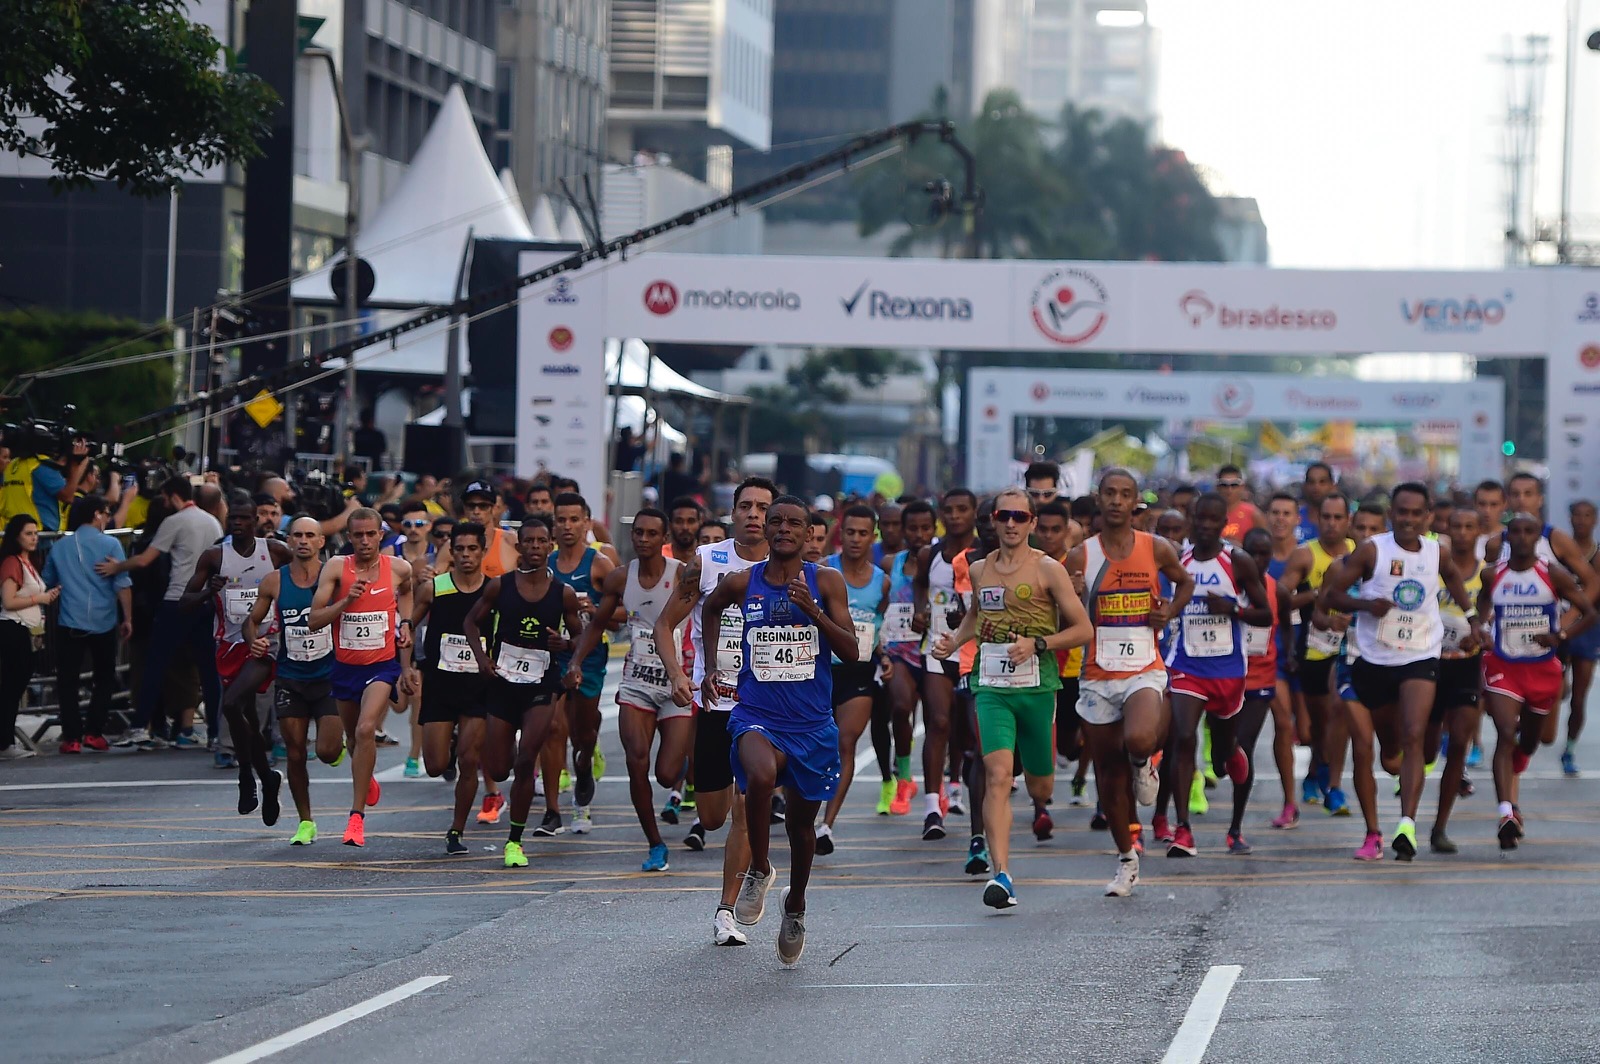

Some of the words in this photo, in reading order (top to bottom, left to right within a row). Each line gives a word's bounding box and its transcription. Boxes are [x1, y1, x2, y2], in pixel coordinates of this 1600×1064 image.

[683, 290, 802, 311] motorola
[869, 291, 973, 320] Rexona
[1220, 306, 1336, 330] bradesco
[1194, 573, 1219, 585] ILA
[1503, 584, 1538, 595] FILA
[356, 626, 370, 638] 23
[756, 631, 812, 642] REGINALDO
[1202, 631, 1216, 642] 15
[1397, 629, 1413, 640] 63
[302, 639, 315, 649] 42
[1119, 643, 1134, 656] 76
[457, 650, 471, 661] 48
[774, 648, 794, 663] 46
[516, 660, 530, 672] 78
[1000, 660, 1016, 673] 79
[631, 670, 668, 687] SPORTS
